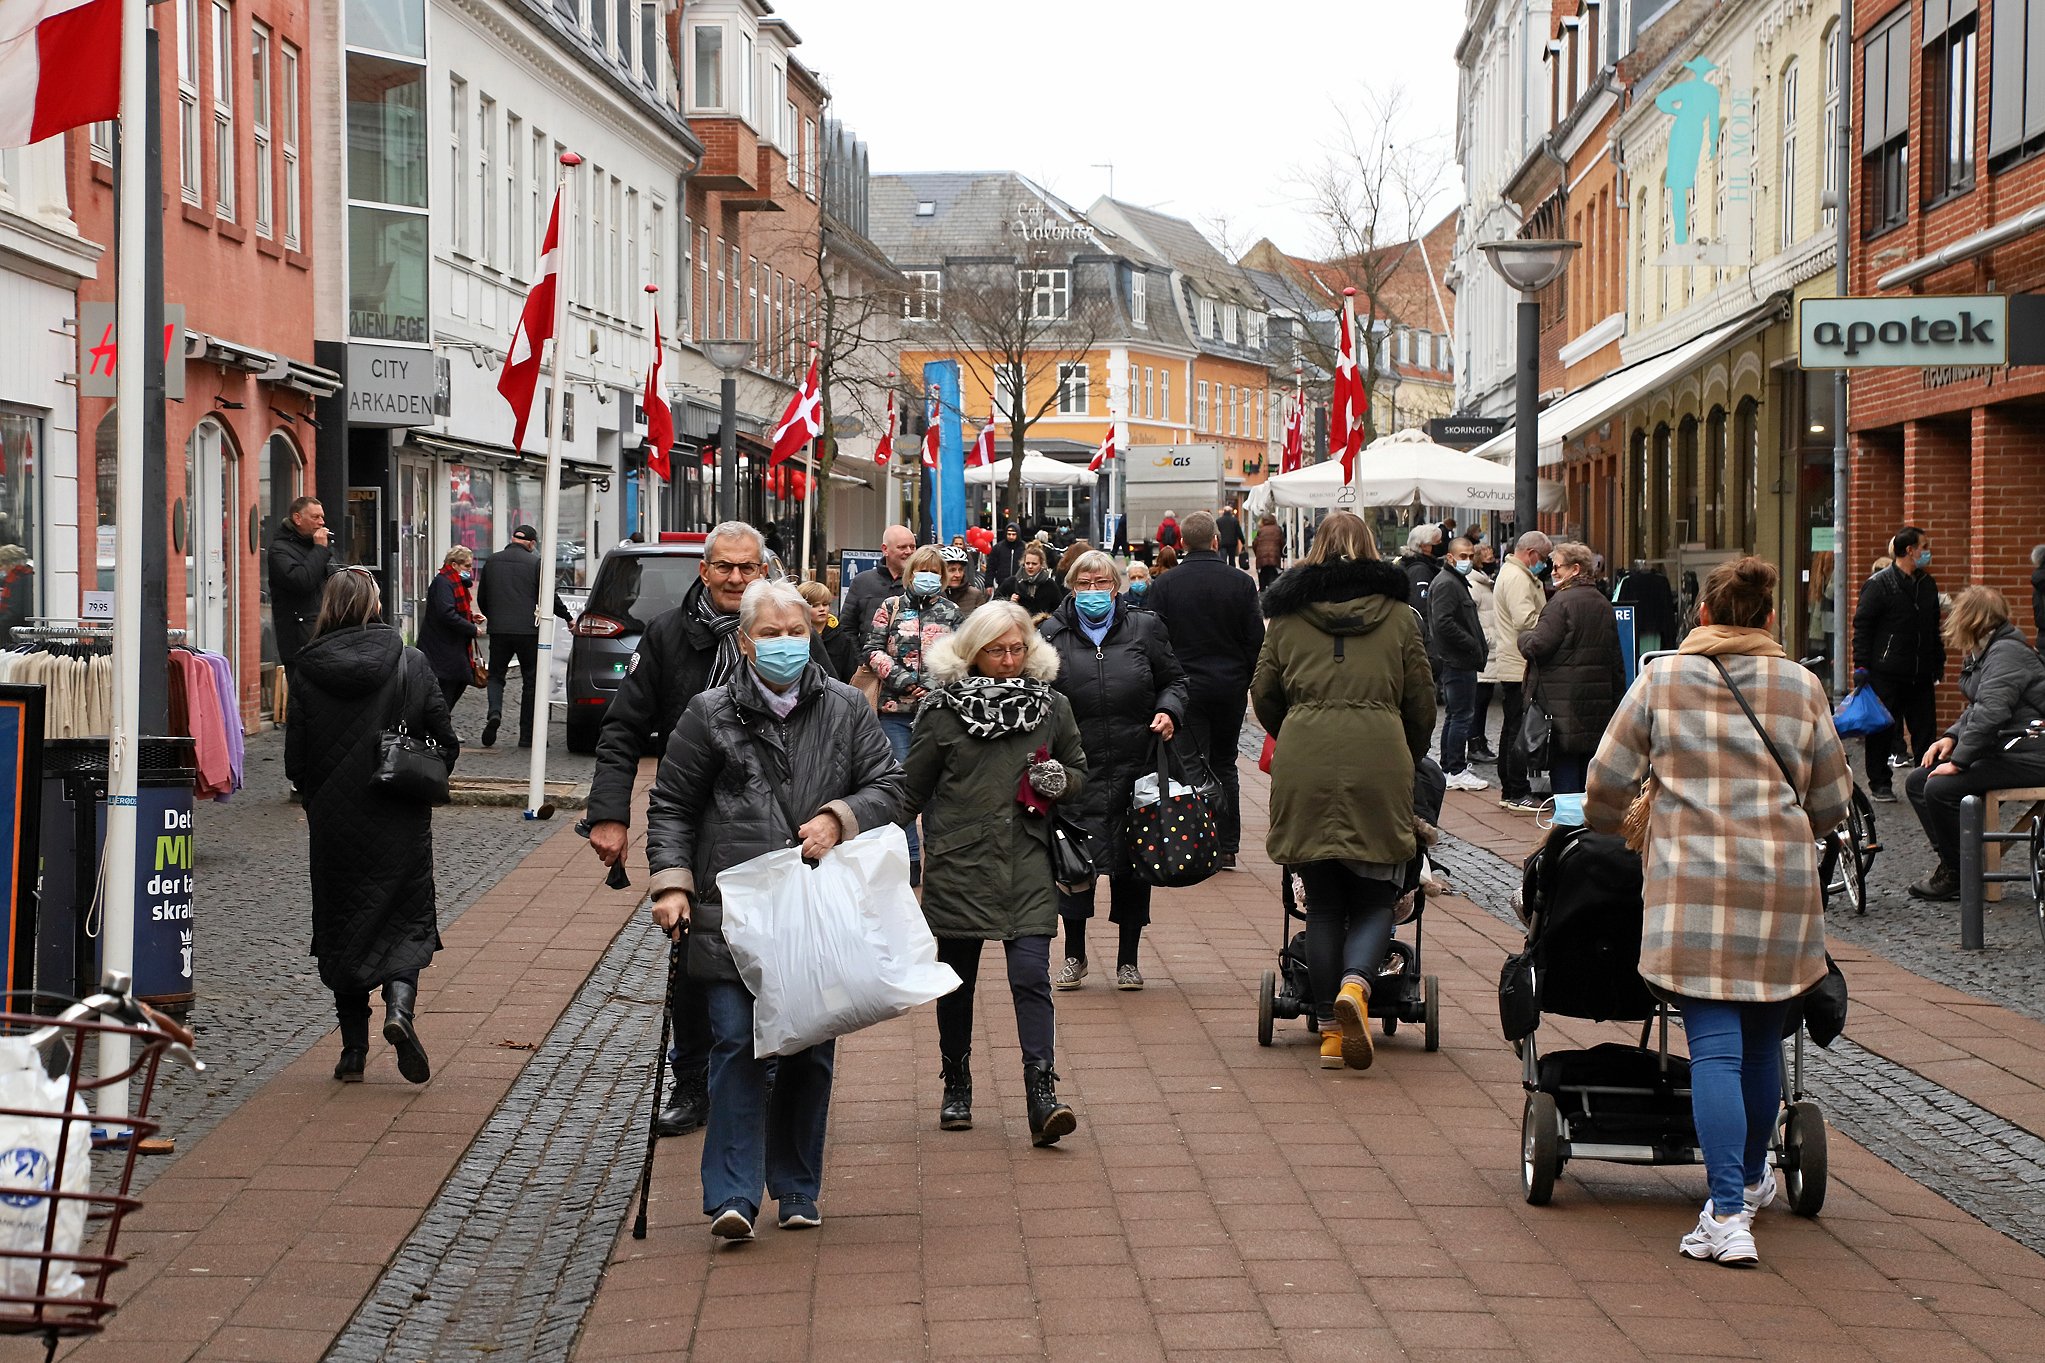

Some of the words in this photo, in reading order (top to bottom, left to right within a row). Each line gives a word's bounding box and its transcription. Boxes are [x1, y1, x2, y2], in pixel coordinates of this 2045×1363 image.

[1731, 89, 1752, 157] MODE
[1813, 311, 1994, 356] apotek
[371, 359, 409, 379] CITY
[349, 392, 433, 415] ARKADEN
[1444, 426, 1494, 434] SKORINGEN
[1173, 457, 1191, 467] GLS
[348, 491, 376, 500] ENU
[1467, 487, 1515, 501] Skovhuus
[89, 603, 108, 612] 79,95
[147, 875, 180, 895] der
[152, 899, 193, 921] skral
